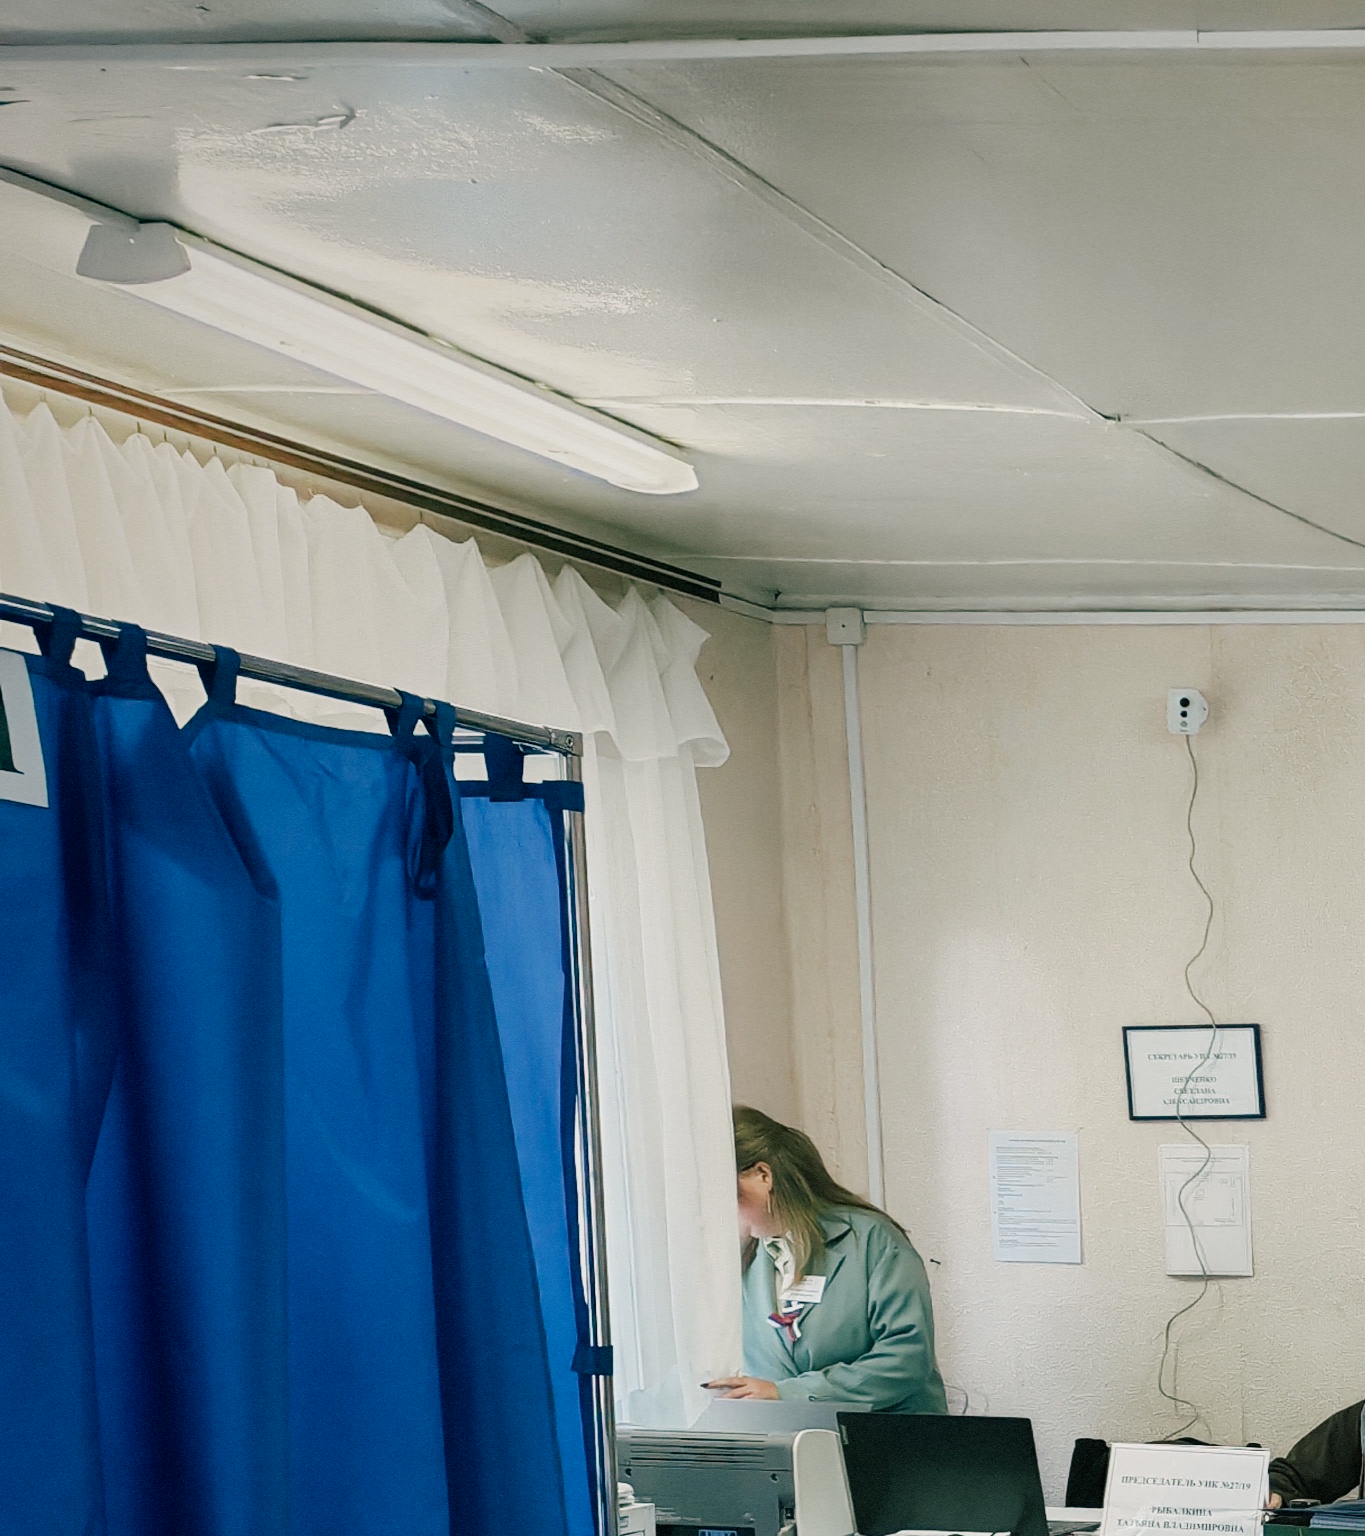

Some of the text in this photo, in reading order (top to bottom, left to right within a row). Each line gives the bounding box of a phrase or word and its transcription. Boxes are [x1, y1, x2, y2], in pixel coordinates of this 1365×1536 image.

[1121, 1475, 1251, 1491] ПРЕДСЕДАТЕЛЬ УИК №27/19
[1151, 1506, 1213, 1517] РЫБАЛКИНА
[1163, 1521, 1245, 1533] ВЛАДИМИРОВНА
